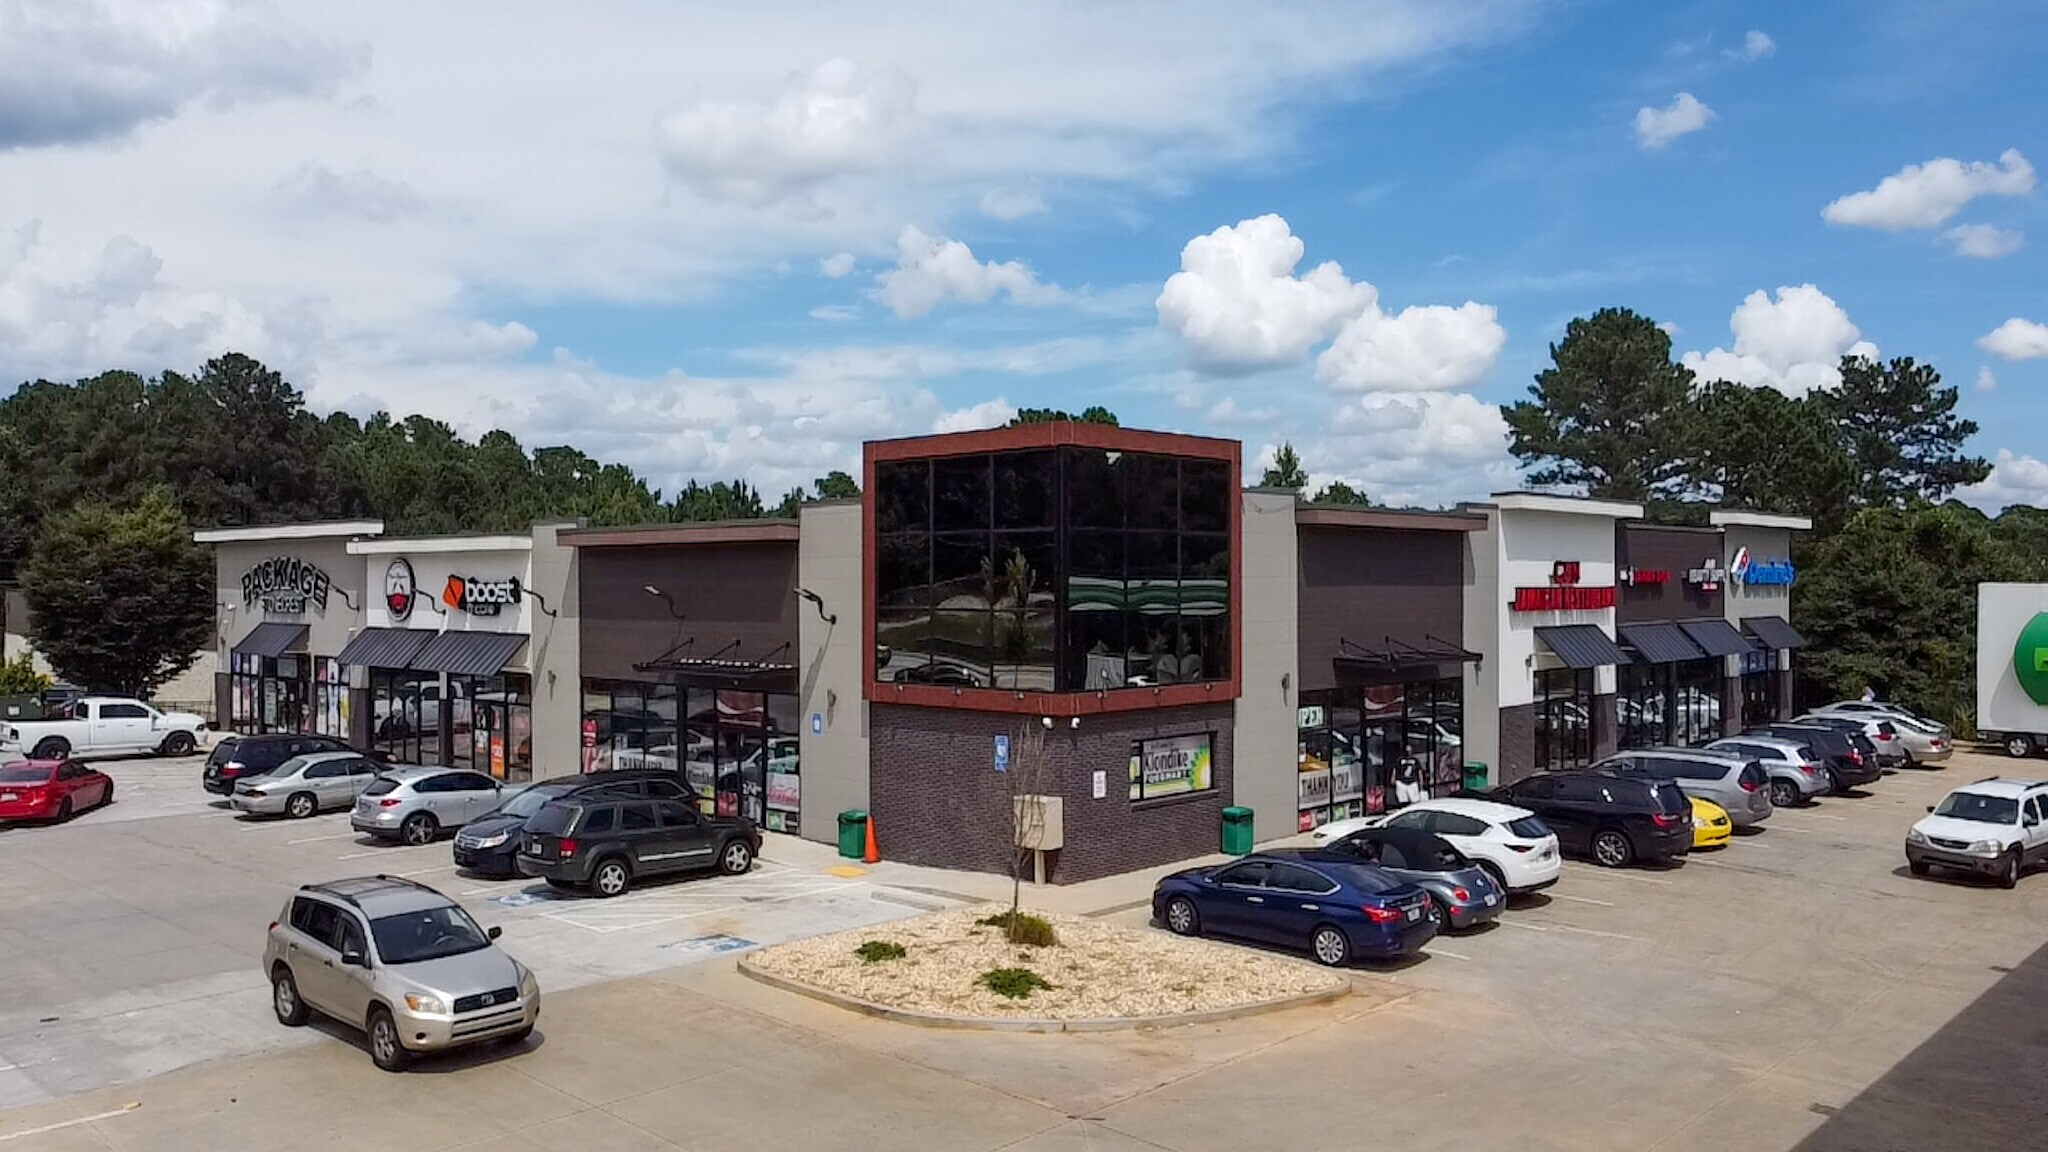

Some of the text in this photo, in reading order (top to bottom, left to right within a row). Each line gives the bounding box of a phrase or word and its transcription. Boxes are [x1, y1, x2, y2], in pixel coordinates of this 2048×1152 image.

[241, 555, 330, 609] PACKAGE
[465, 580, 515, 603] boost
[1142, 749, 1188, 772] Klondike
